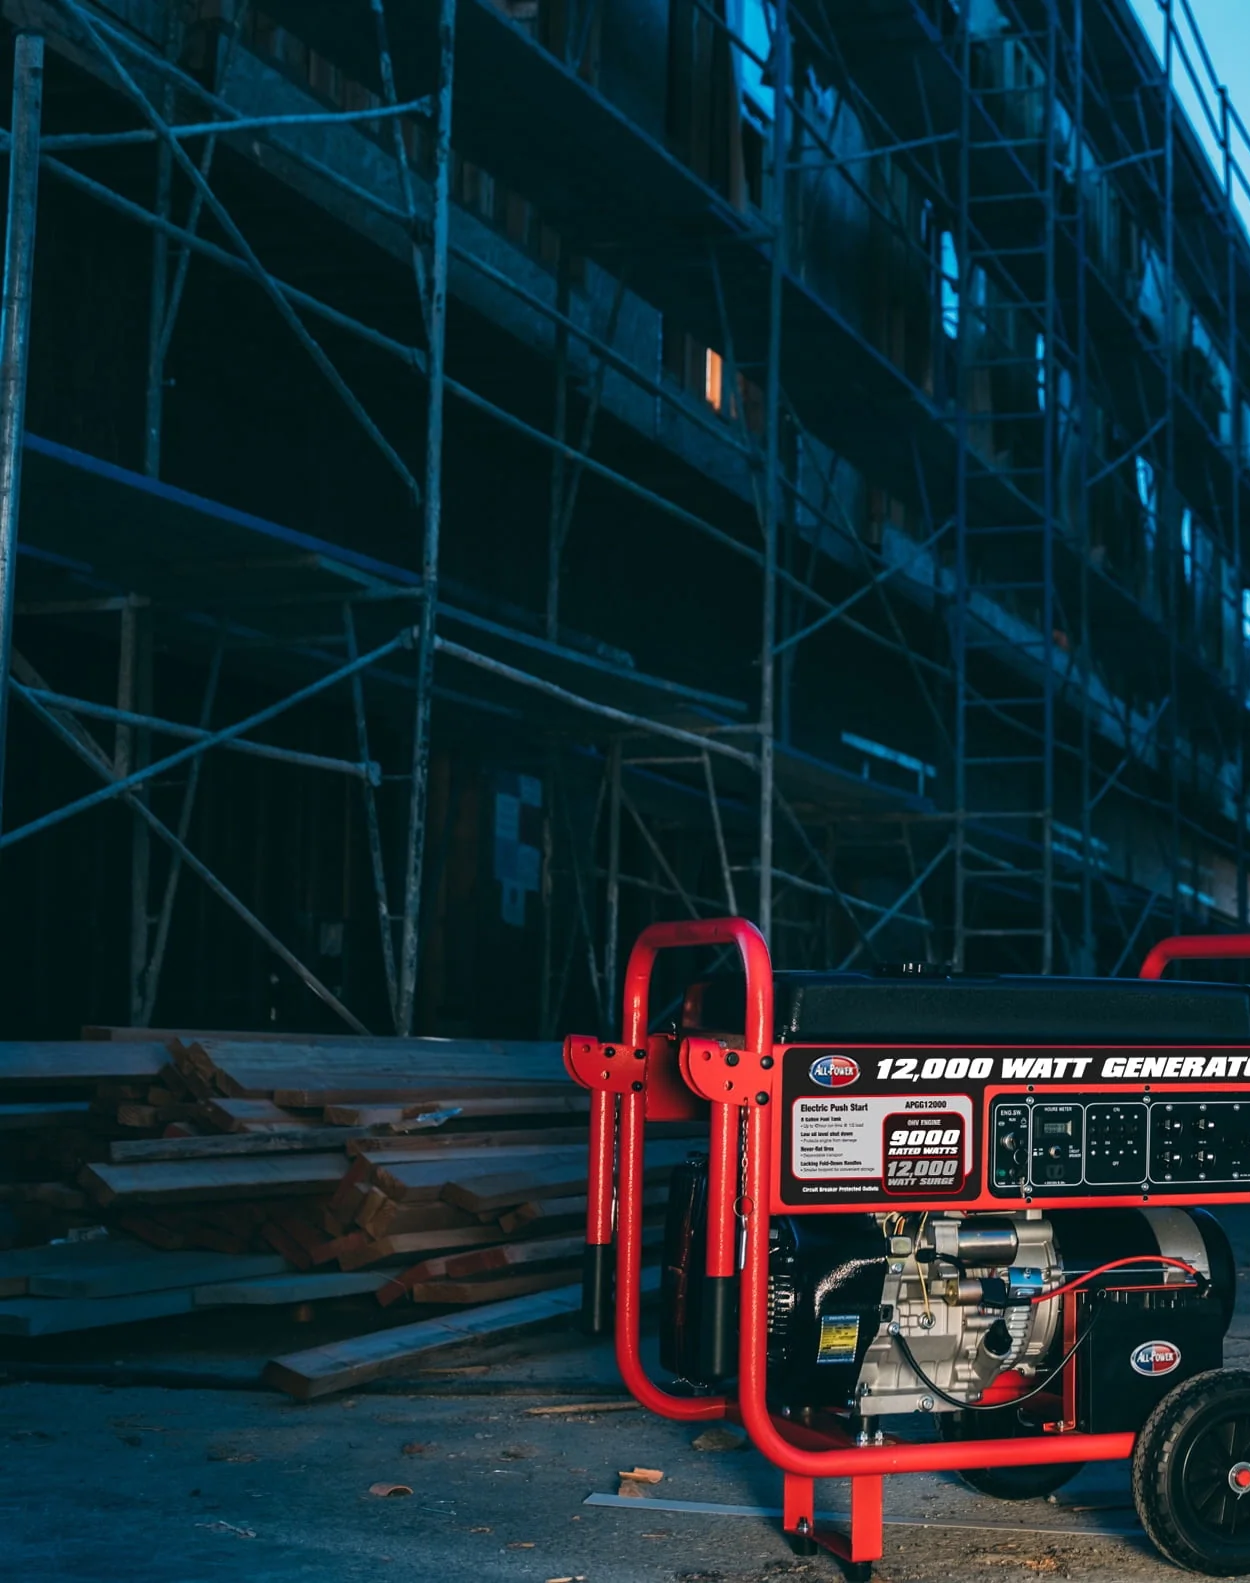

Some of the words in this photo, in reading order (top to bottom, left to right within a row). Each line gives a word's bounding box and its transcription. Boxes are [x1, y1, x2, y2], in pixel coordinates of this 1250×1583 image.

[877, 1058, 994, 1082] 12,000
[1001, 1057, 1093, 1078] WATT
[800, 1103, 828, 1113] Electric
[830, 1102, 849, 1112] Push
[850, 1102, 869, 1112] Start
[905, 1100, 947, 1109] APGG12000
[889, 1129, 961, 1146] 9000
[888, 1147, 922, 1156] RATED
[922, 1146, 959, 1155] WATTS
[887, 1160, 959, 1178] 12,000
[887, 1178, 918, 1186] WATT
[918, 1177, 955, 1185] SURGE
